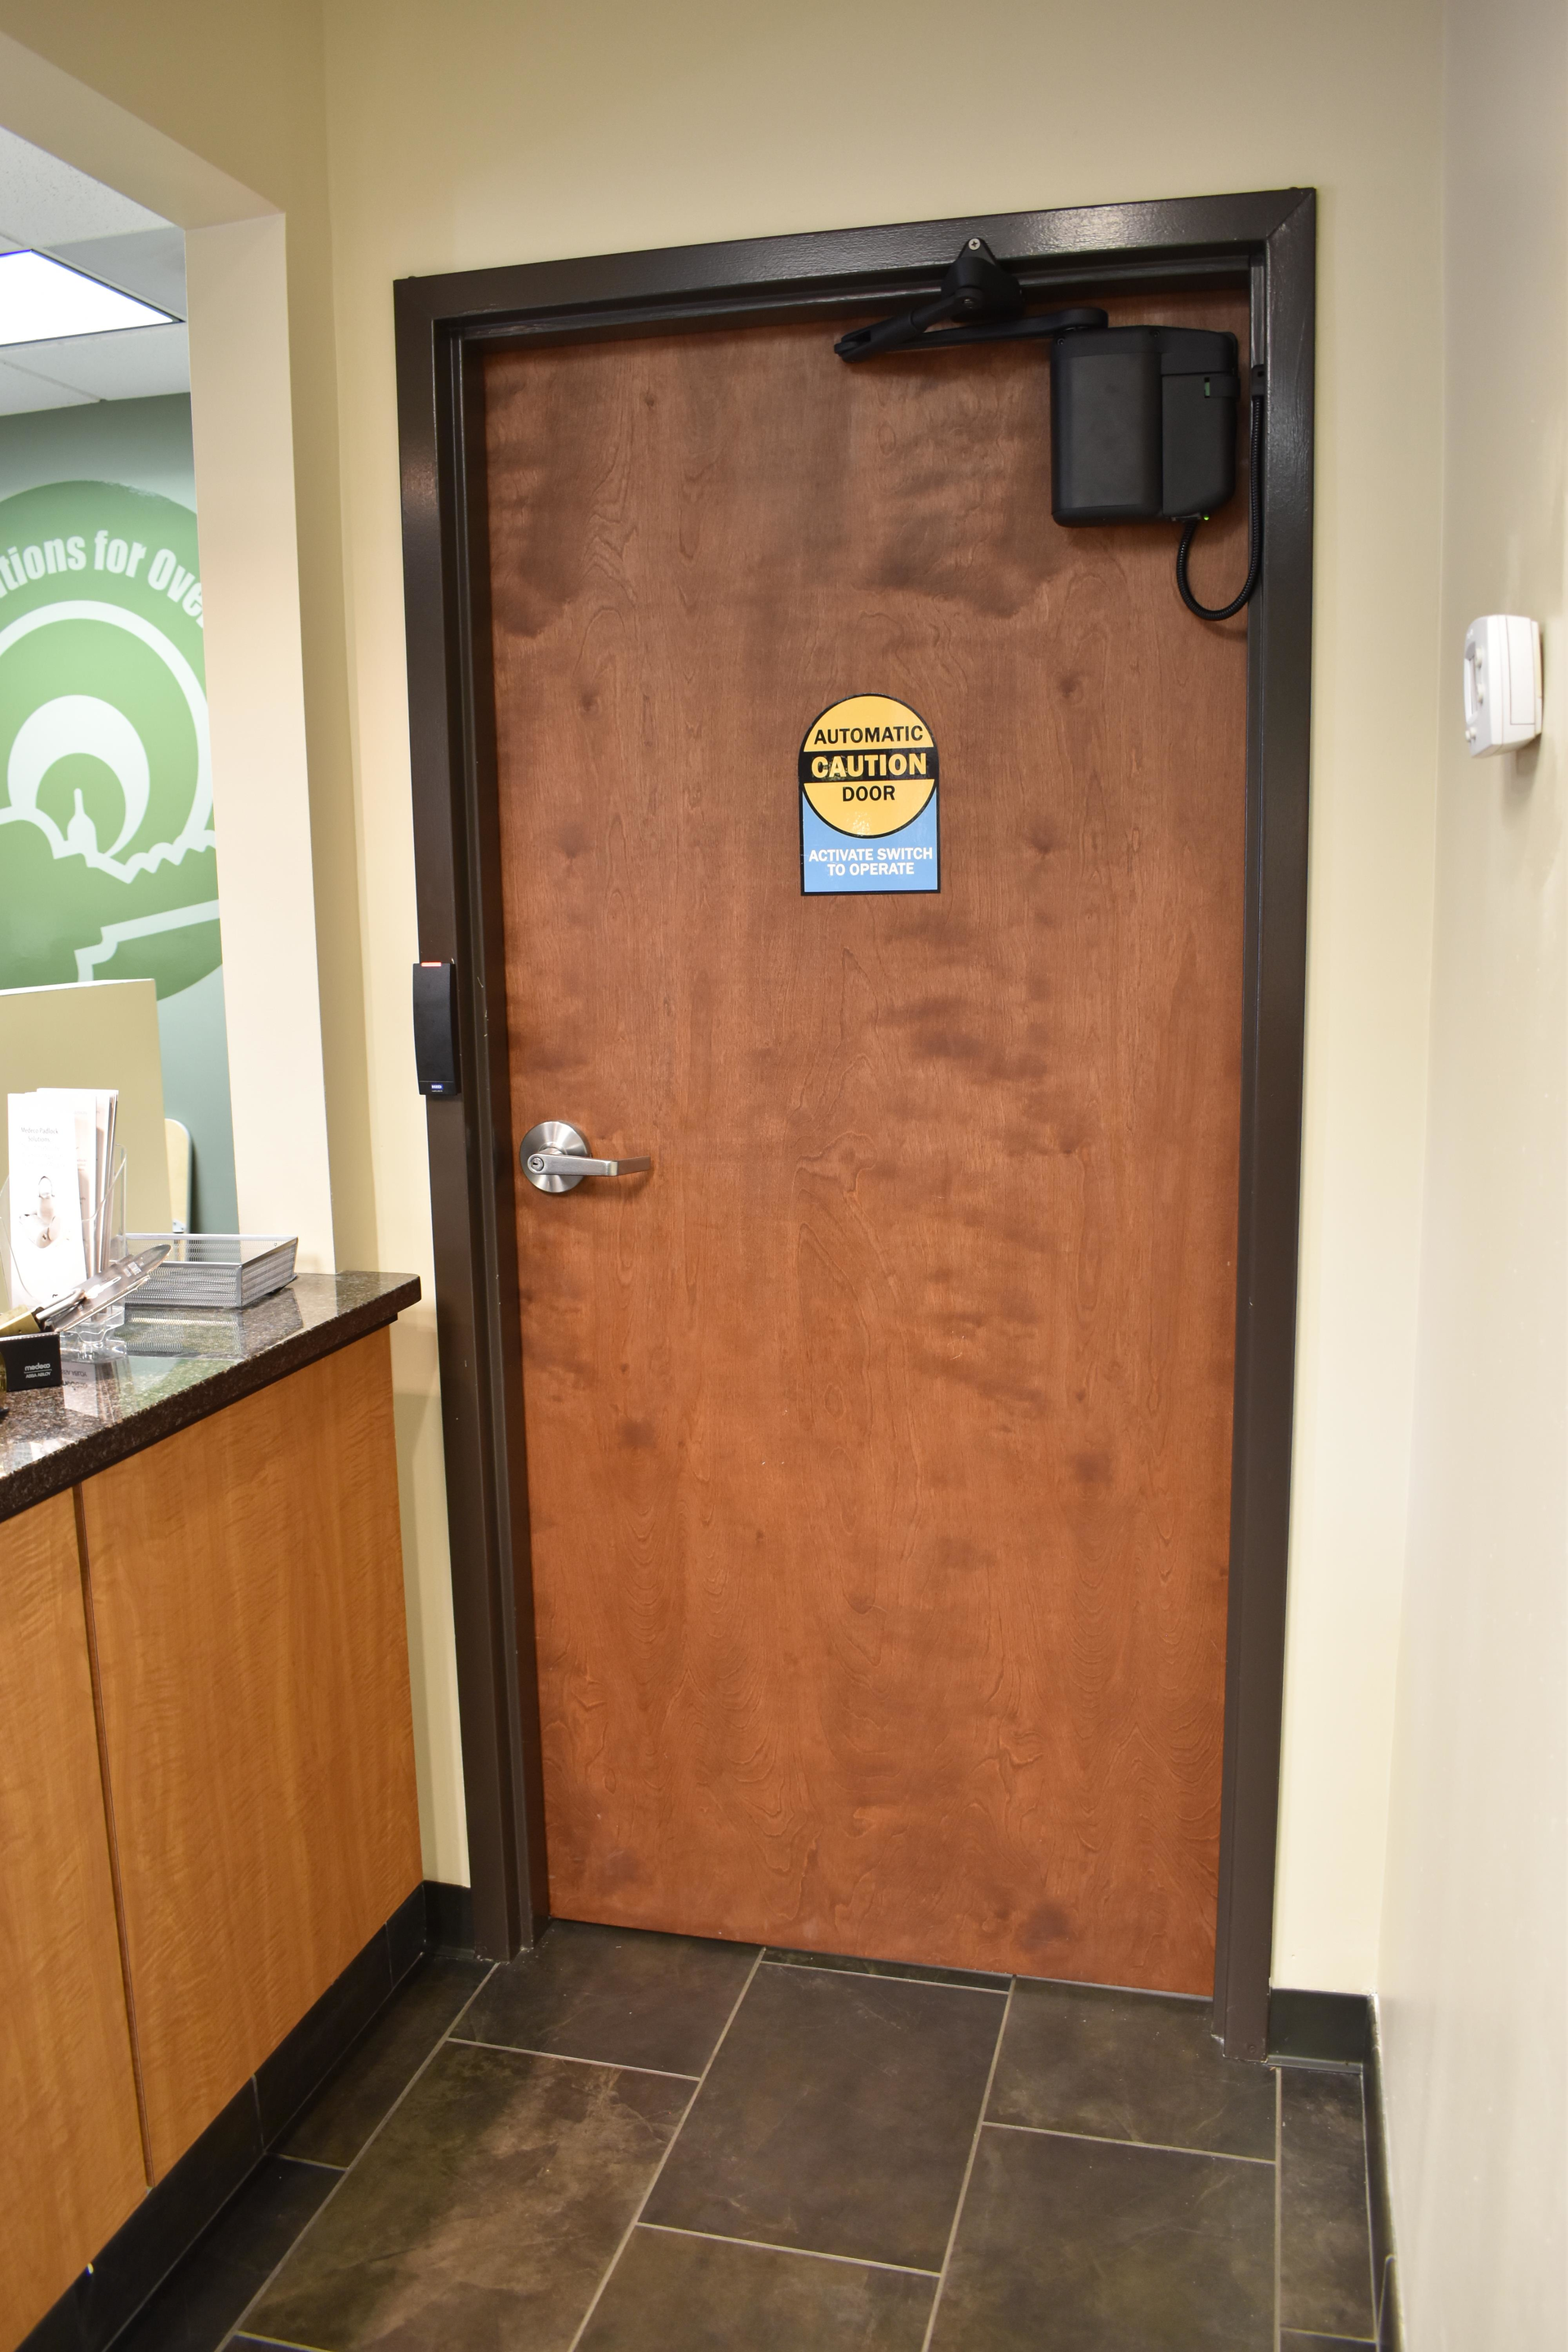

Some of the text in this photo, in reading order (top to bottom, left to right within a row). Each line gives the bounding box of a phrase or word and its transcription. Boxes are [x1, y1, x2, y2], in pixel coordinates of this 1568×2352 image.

[0, 529, 203, 628] tions for Ove
[813, 725, 924, 745] AUTOMATIC
[811, 753, 927, 778] CAUTION
[842, 785, 895, 802] DOOR
[808, 847, 933, 862] ACTIVATE SWITCH
[827, 862, 915, 876] TO OPERATE
[24, 1362, 51, 1371] medeco
